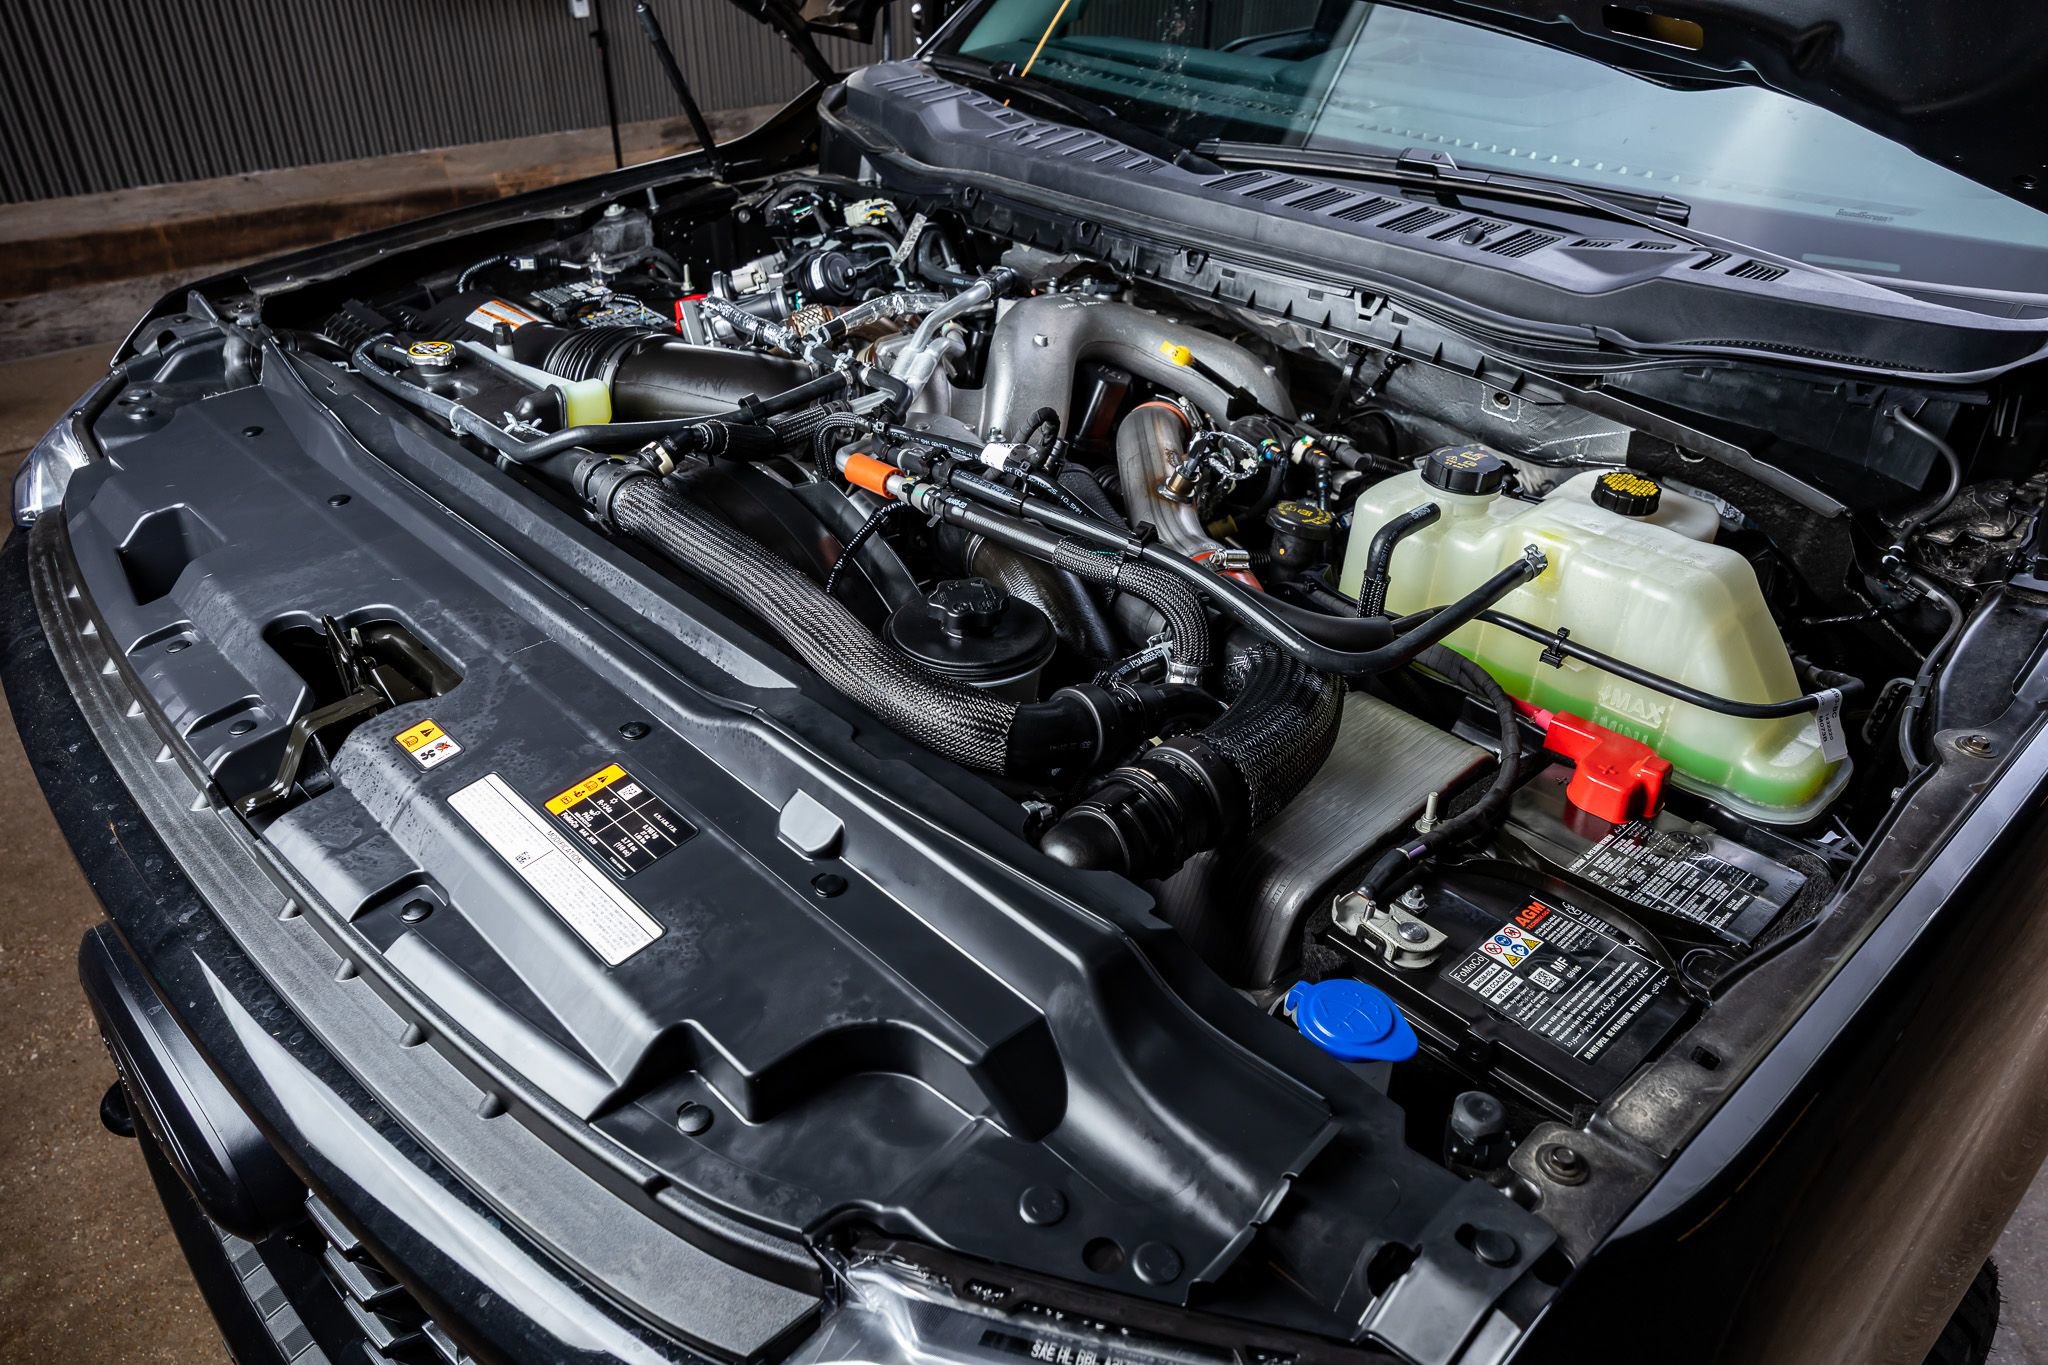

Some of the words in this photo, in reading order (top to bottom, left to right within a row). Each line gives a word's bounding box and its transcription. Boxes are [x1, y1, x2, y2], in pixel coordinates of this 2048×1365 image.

[1610, 688, 1666, 724] MAX
[547, 830, 583, 864] MODIFICATION
[1512, 900, 1546, 927] AGM
[1452, 954, 1486, 981] FoMoCo
[1549, 955, 1571, 972] MF
[1031, 1339, 1057, 1362] SAE
